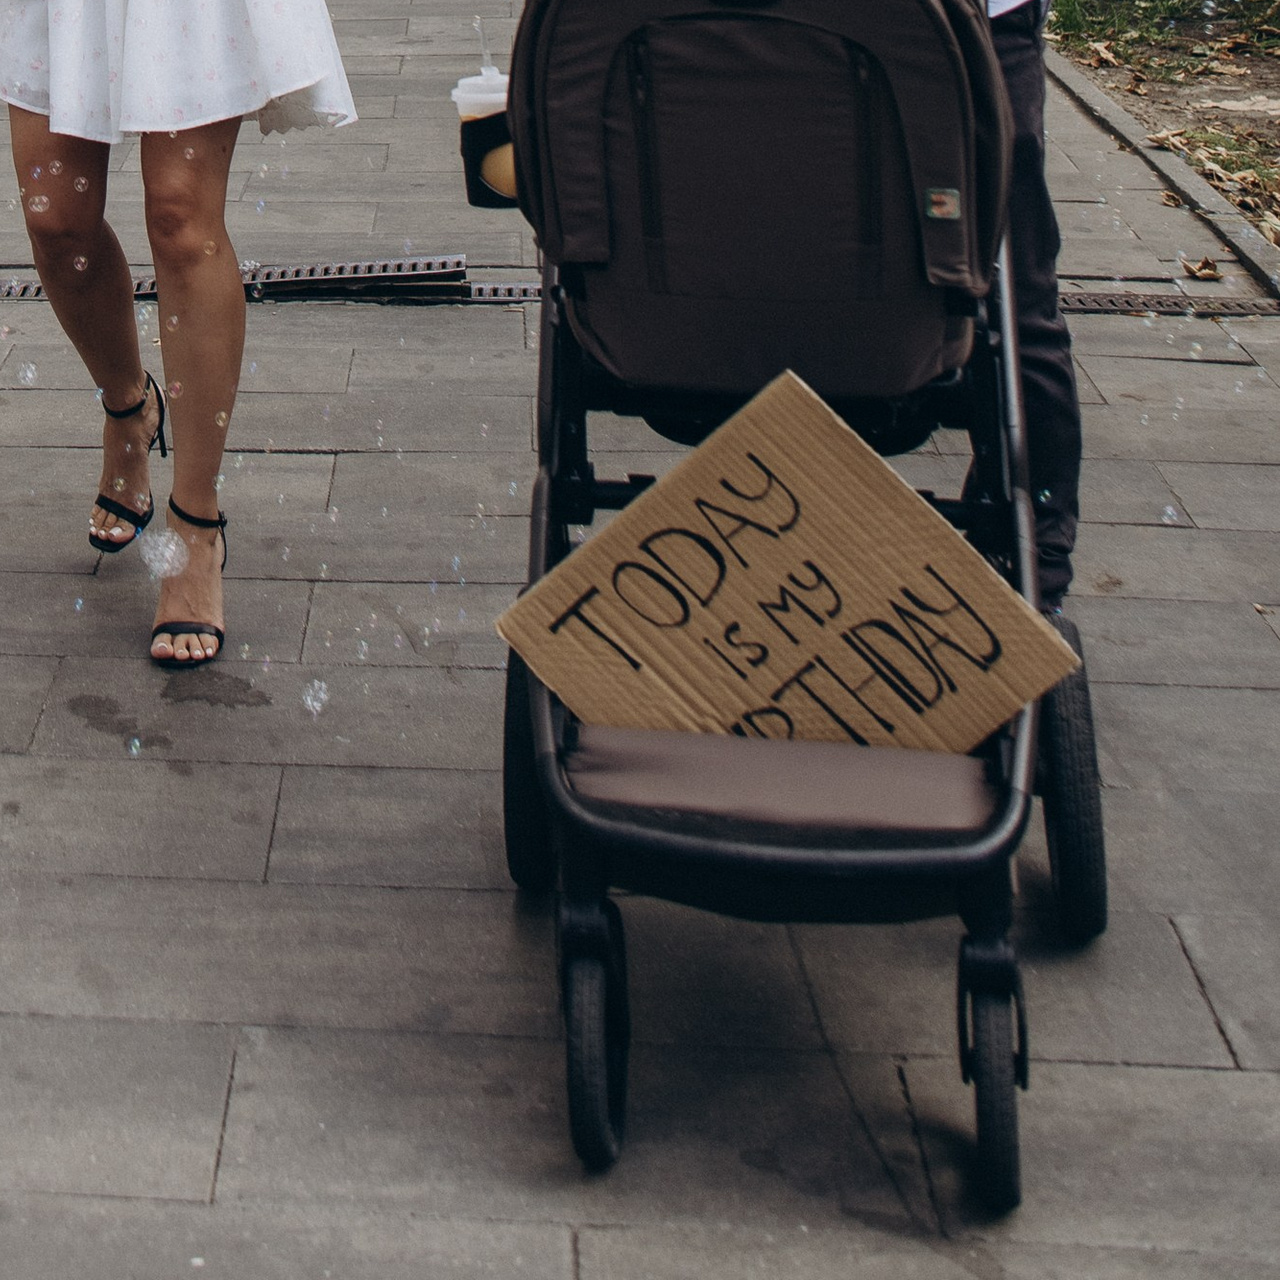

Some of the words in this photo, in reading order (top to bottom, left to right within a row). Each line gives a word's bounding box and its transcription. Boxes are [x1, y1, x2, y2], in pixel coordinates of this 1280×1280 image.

[549, 452, 801, 671] TODAY
[703, 620, 769, 680] IS
[756, 559, 843, 644] MY
